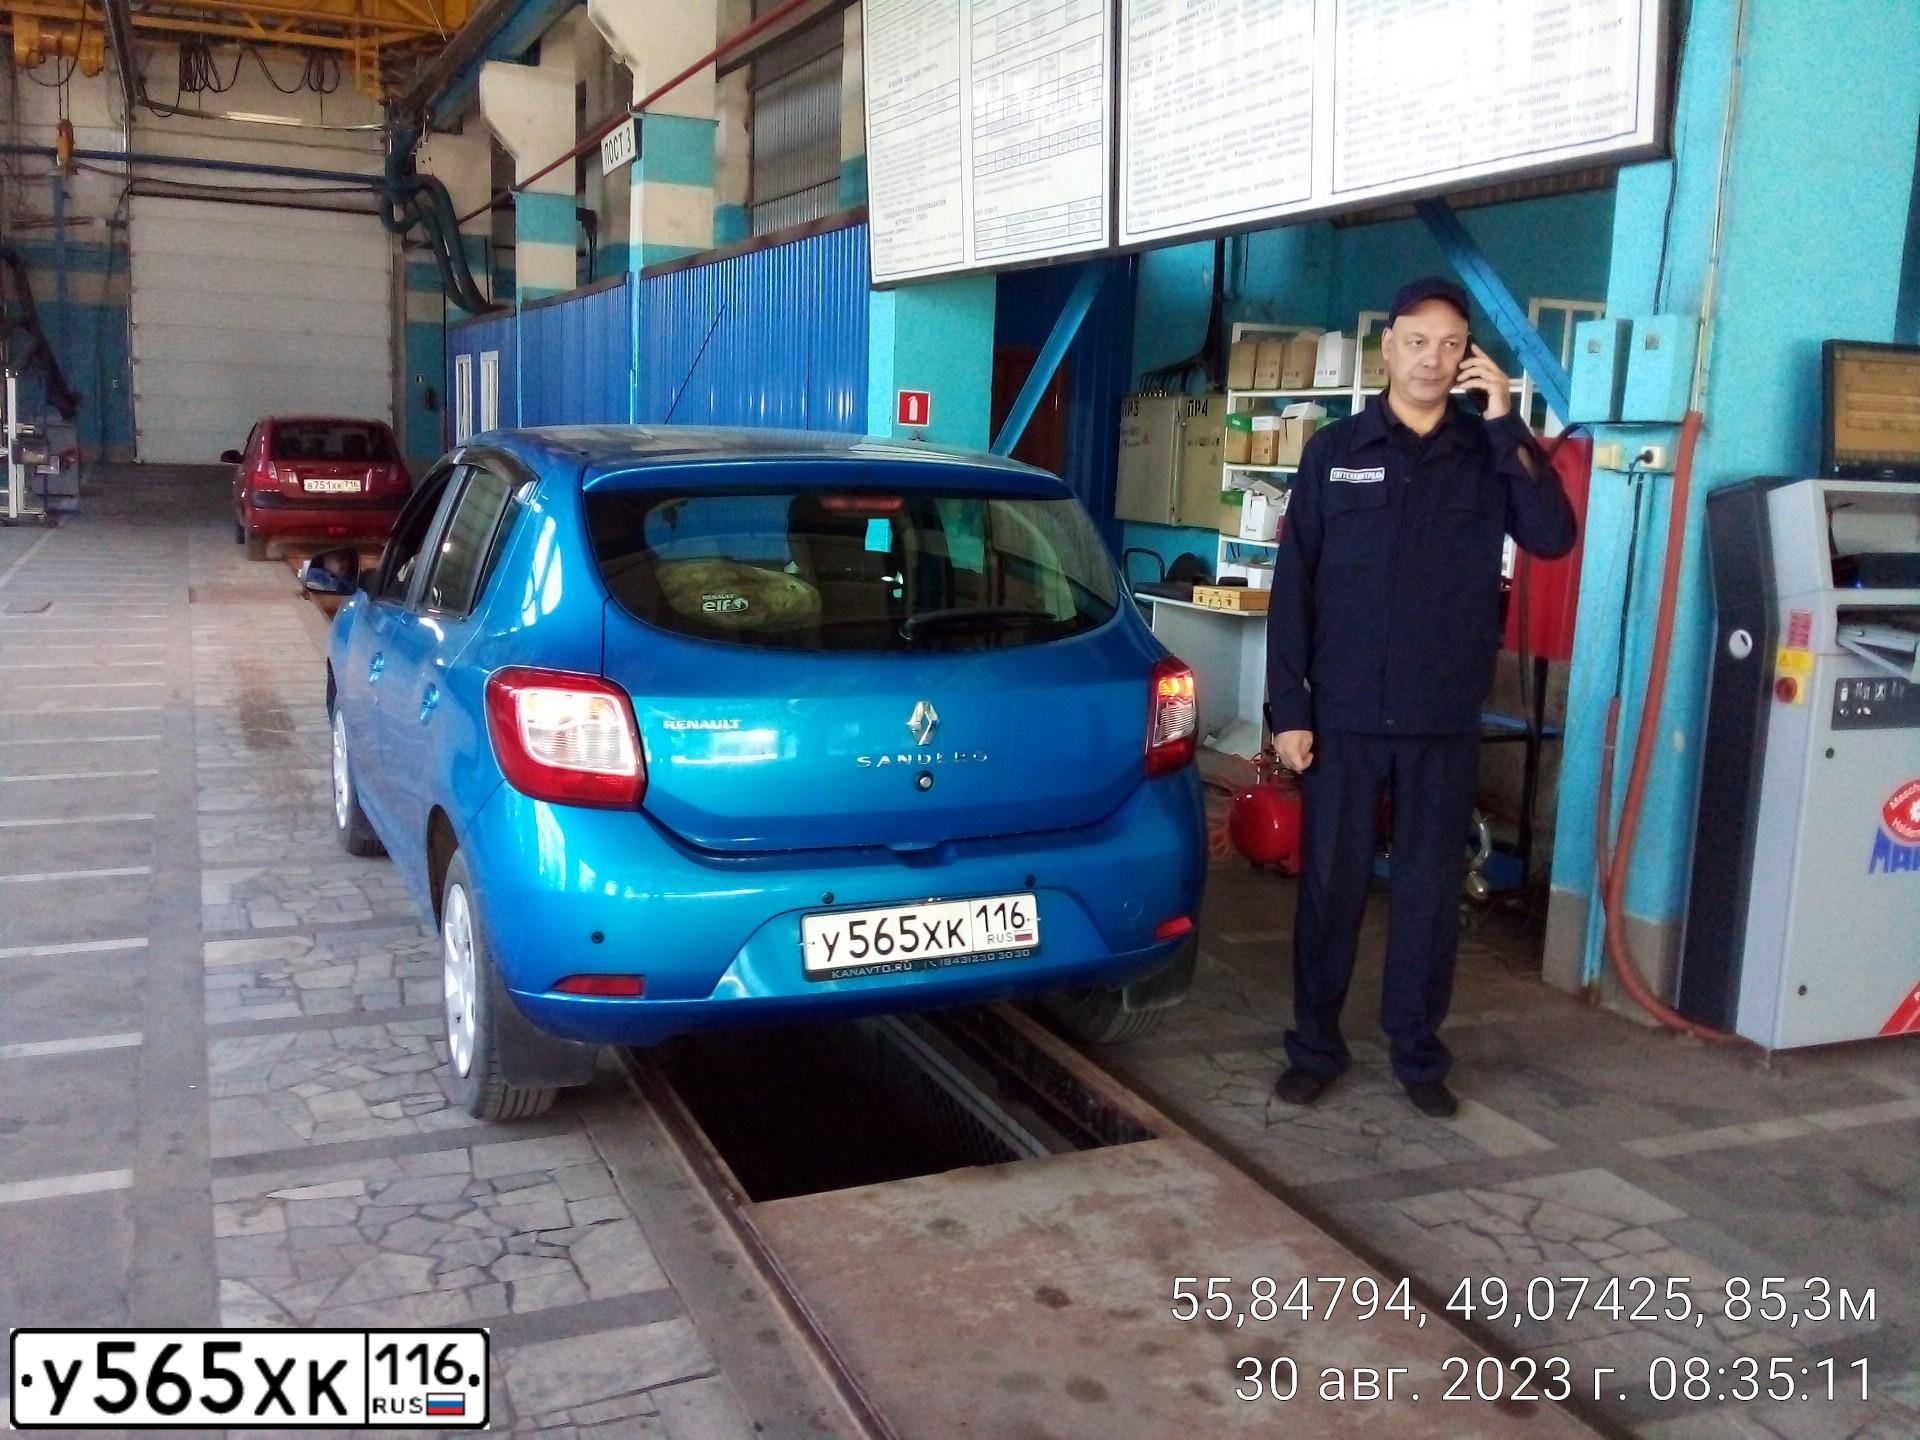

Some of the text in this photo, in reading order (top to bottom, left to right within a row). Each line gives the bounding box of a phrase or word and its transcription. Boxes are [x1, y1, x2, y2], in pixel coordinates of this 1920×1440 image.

[604, 126, 632, 166] ПОСТ 3
[703, 599, 732, 612] elf
[662, 719, 742, 730] RENAULT
[821, 901, 1025, 962] У565ХК 116
[987, 932, 1013, 945] RUS
[831, 961, 912, 979] KANAVTO.RU
